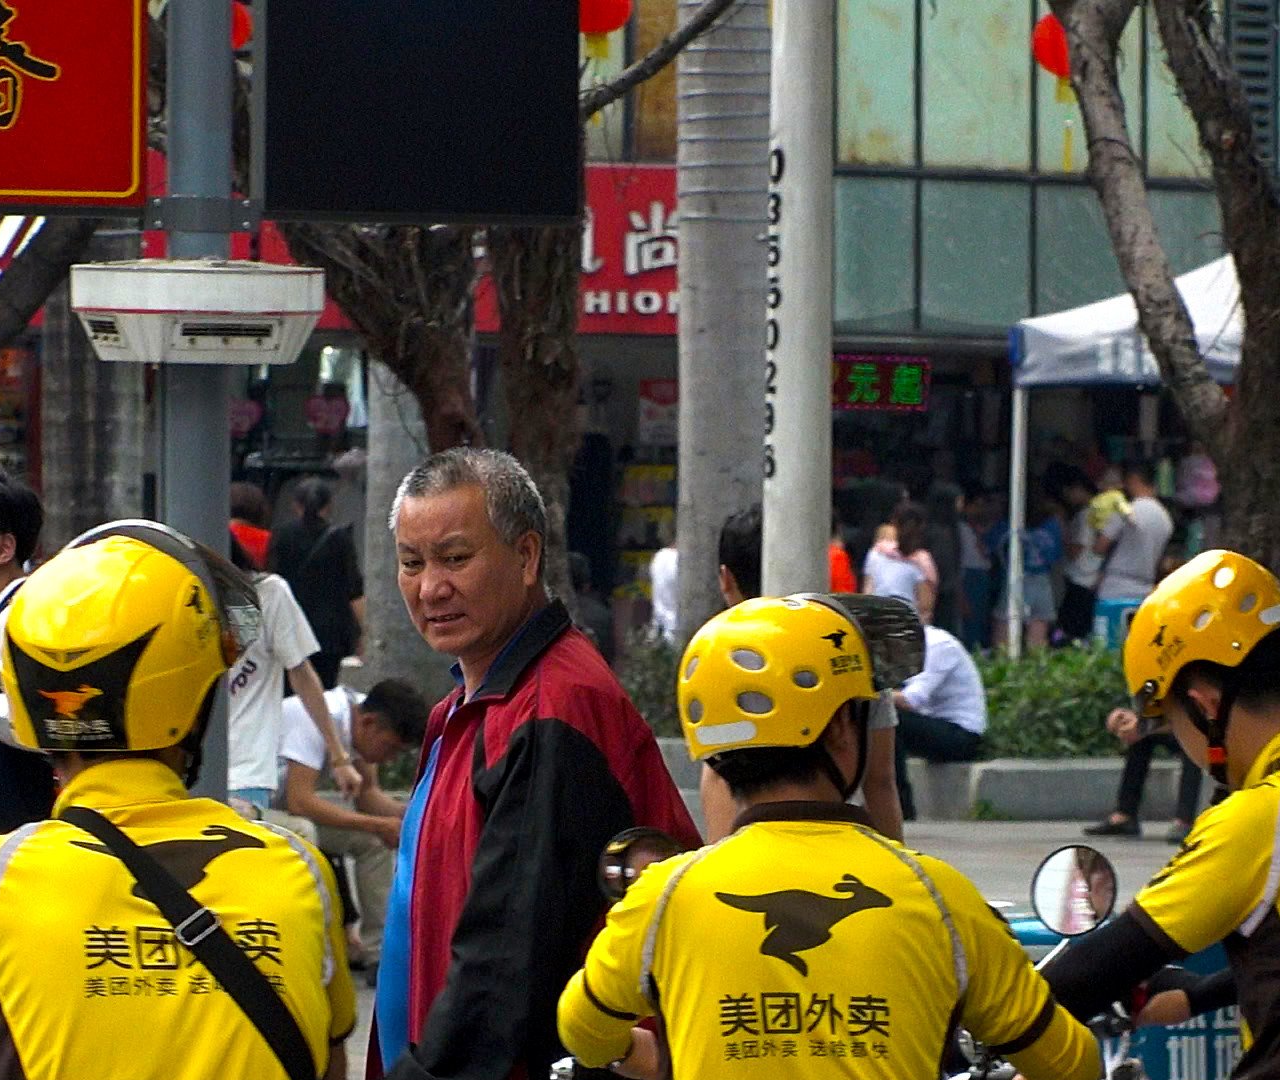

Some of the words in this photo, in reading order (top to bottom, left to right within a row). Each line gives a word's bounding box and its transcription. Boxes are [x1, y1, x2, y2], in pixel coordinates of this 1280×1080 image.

[580, 201, 679, 274] 尚
[84, 918, 283, 970] 美团卖
[718, 991, 891, 1038] 美团外卖
[723, 1039, 801, 1061] 美团外卖
